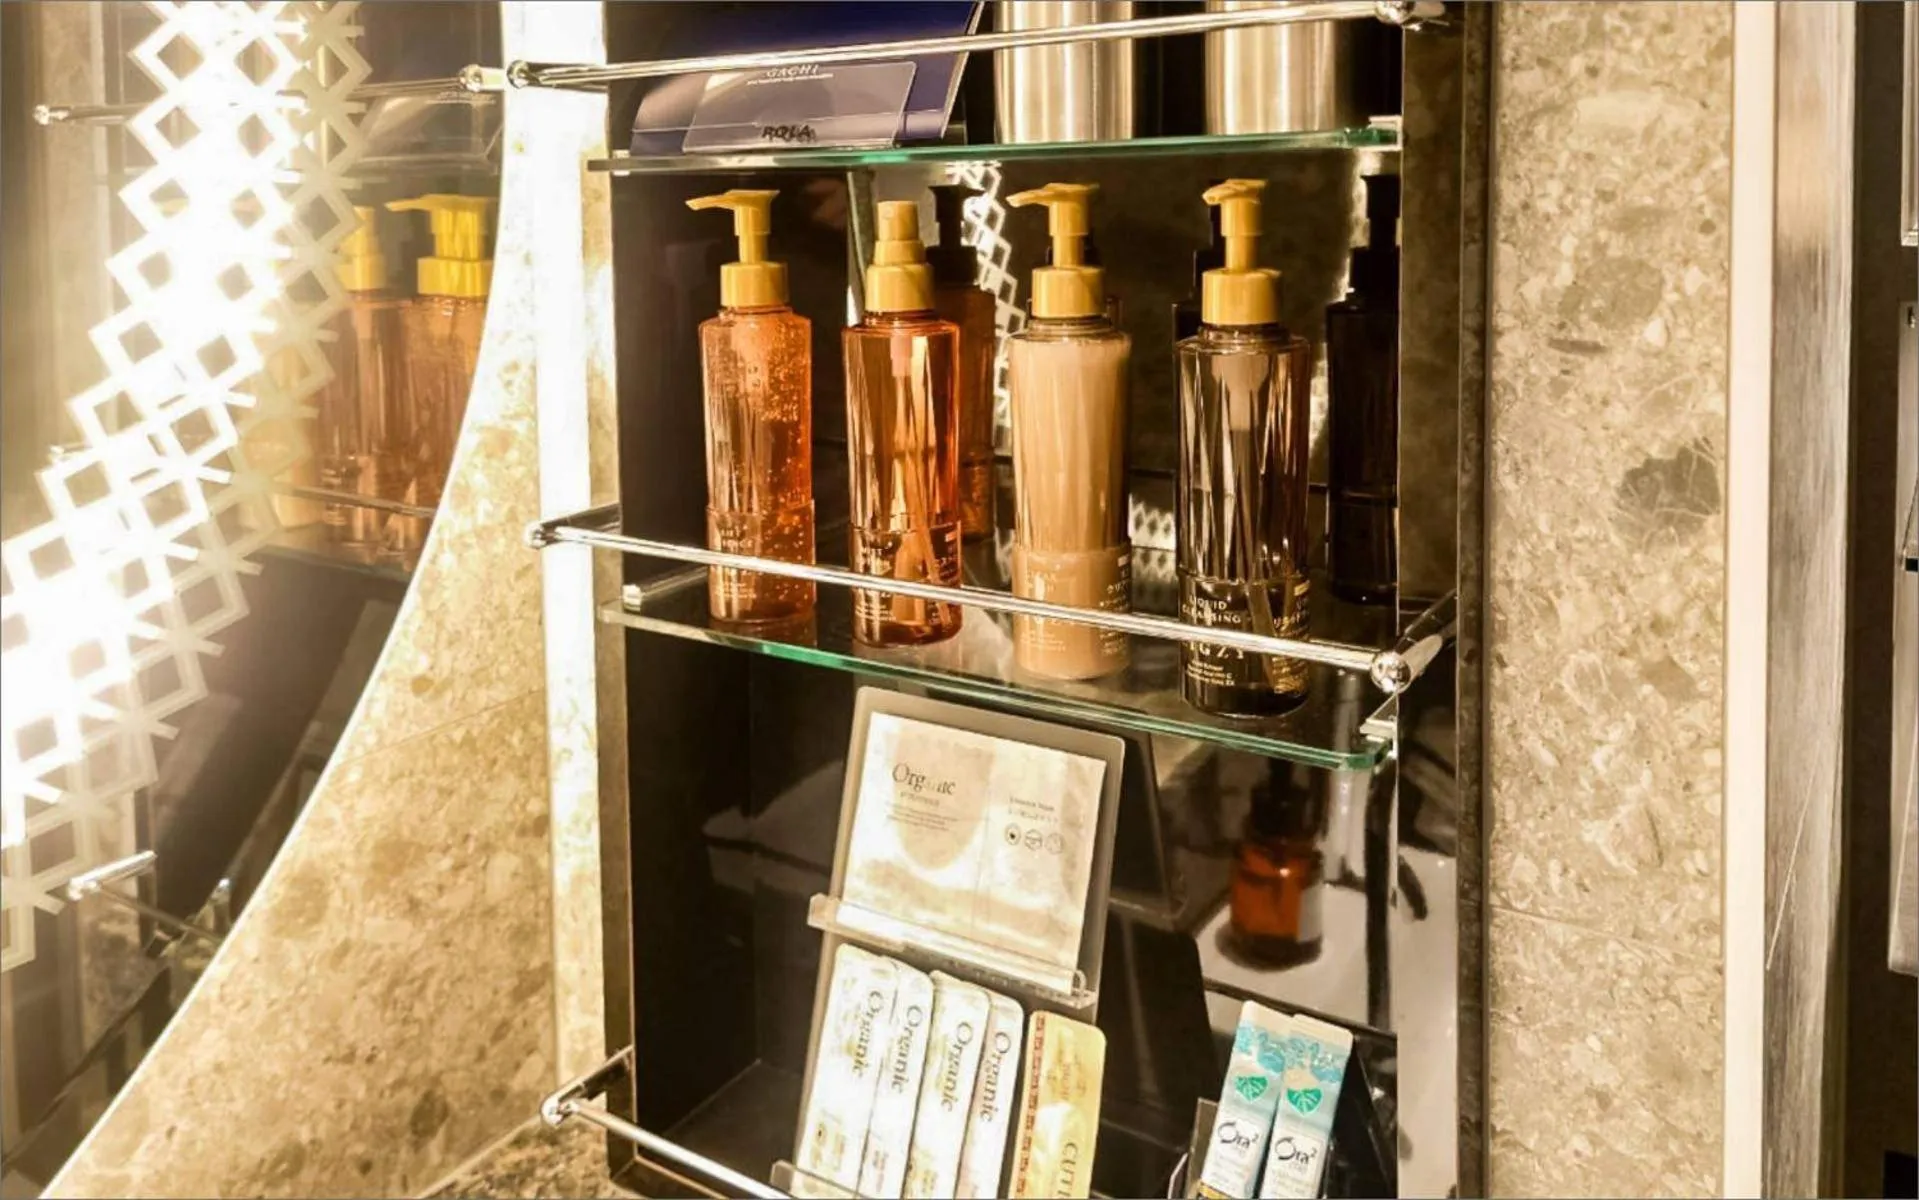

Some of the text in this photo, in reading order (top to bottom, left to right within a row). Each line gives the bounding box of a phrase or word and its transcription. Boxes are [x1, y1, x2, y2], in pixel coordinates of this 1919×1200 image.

[1182, 603, 1241, 623] CLASING
[1189, 595, 1228, 611] LQID
[891, 1005, 923, 1094] Organic
[940, 1021, 974, 1113] Organic
[980, 1032, 1012, 1123] Organic
